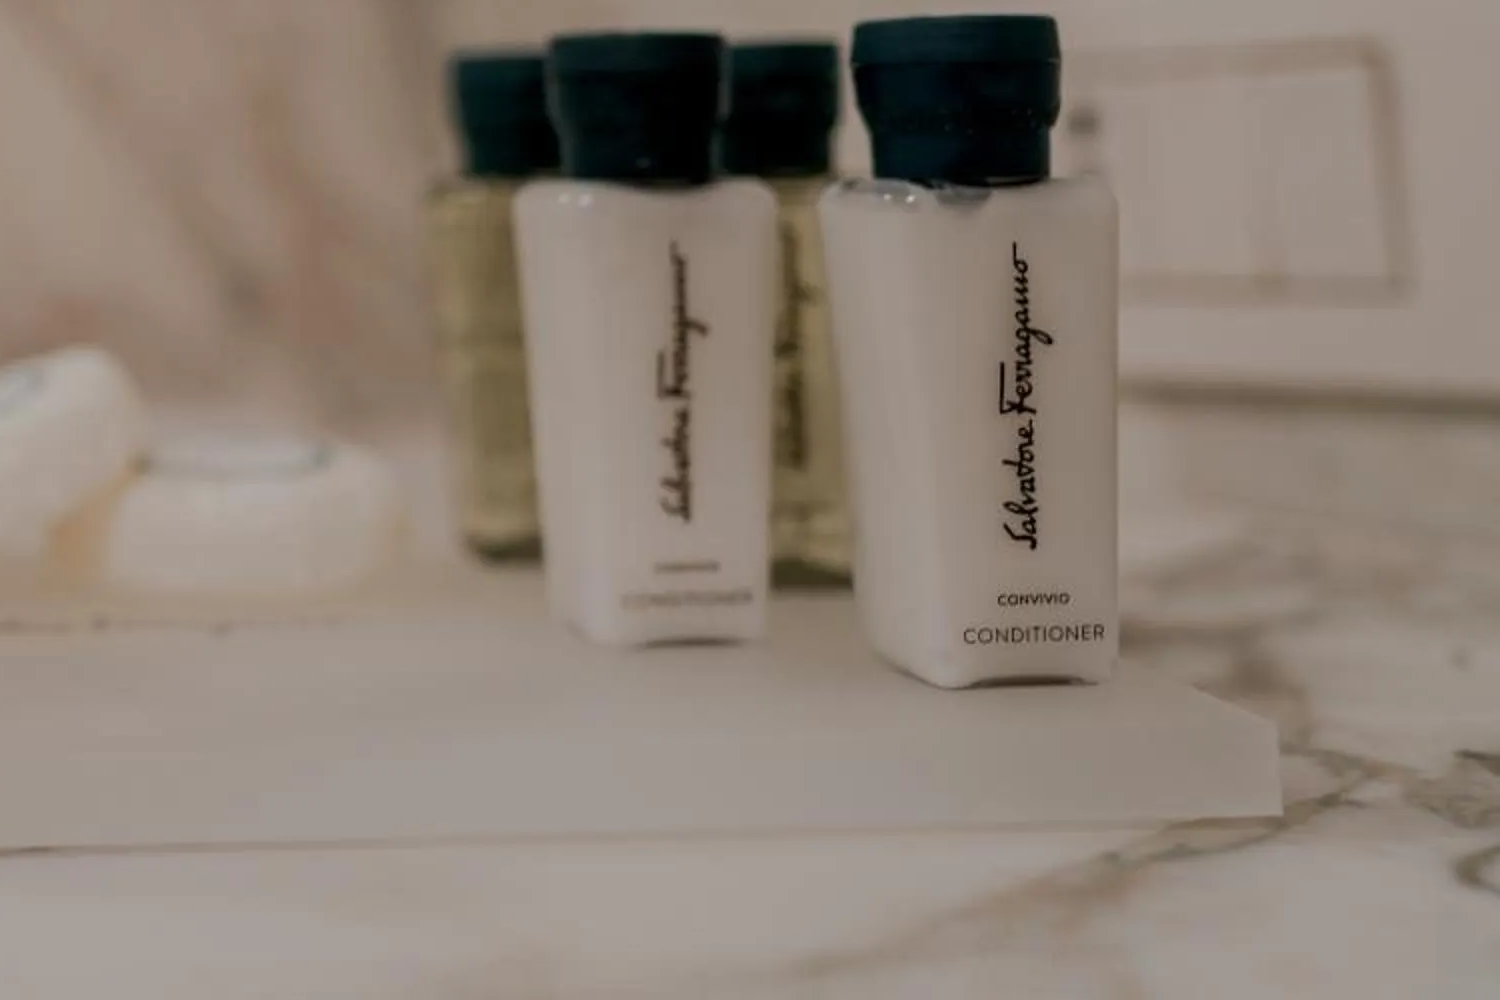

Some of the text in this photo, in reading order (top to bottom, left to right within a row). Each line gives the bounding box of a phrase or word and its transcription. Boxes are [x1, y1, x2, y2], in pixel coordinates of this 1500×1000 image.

[999, 241, 1054, 550] Salvatore Ferragamo
[997, 592, 1072, 607] CONVIVIO
[962, 623, 1106, 646] CONDITIONER
